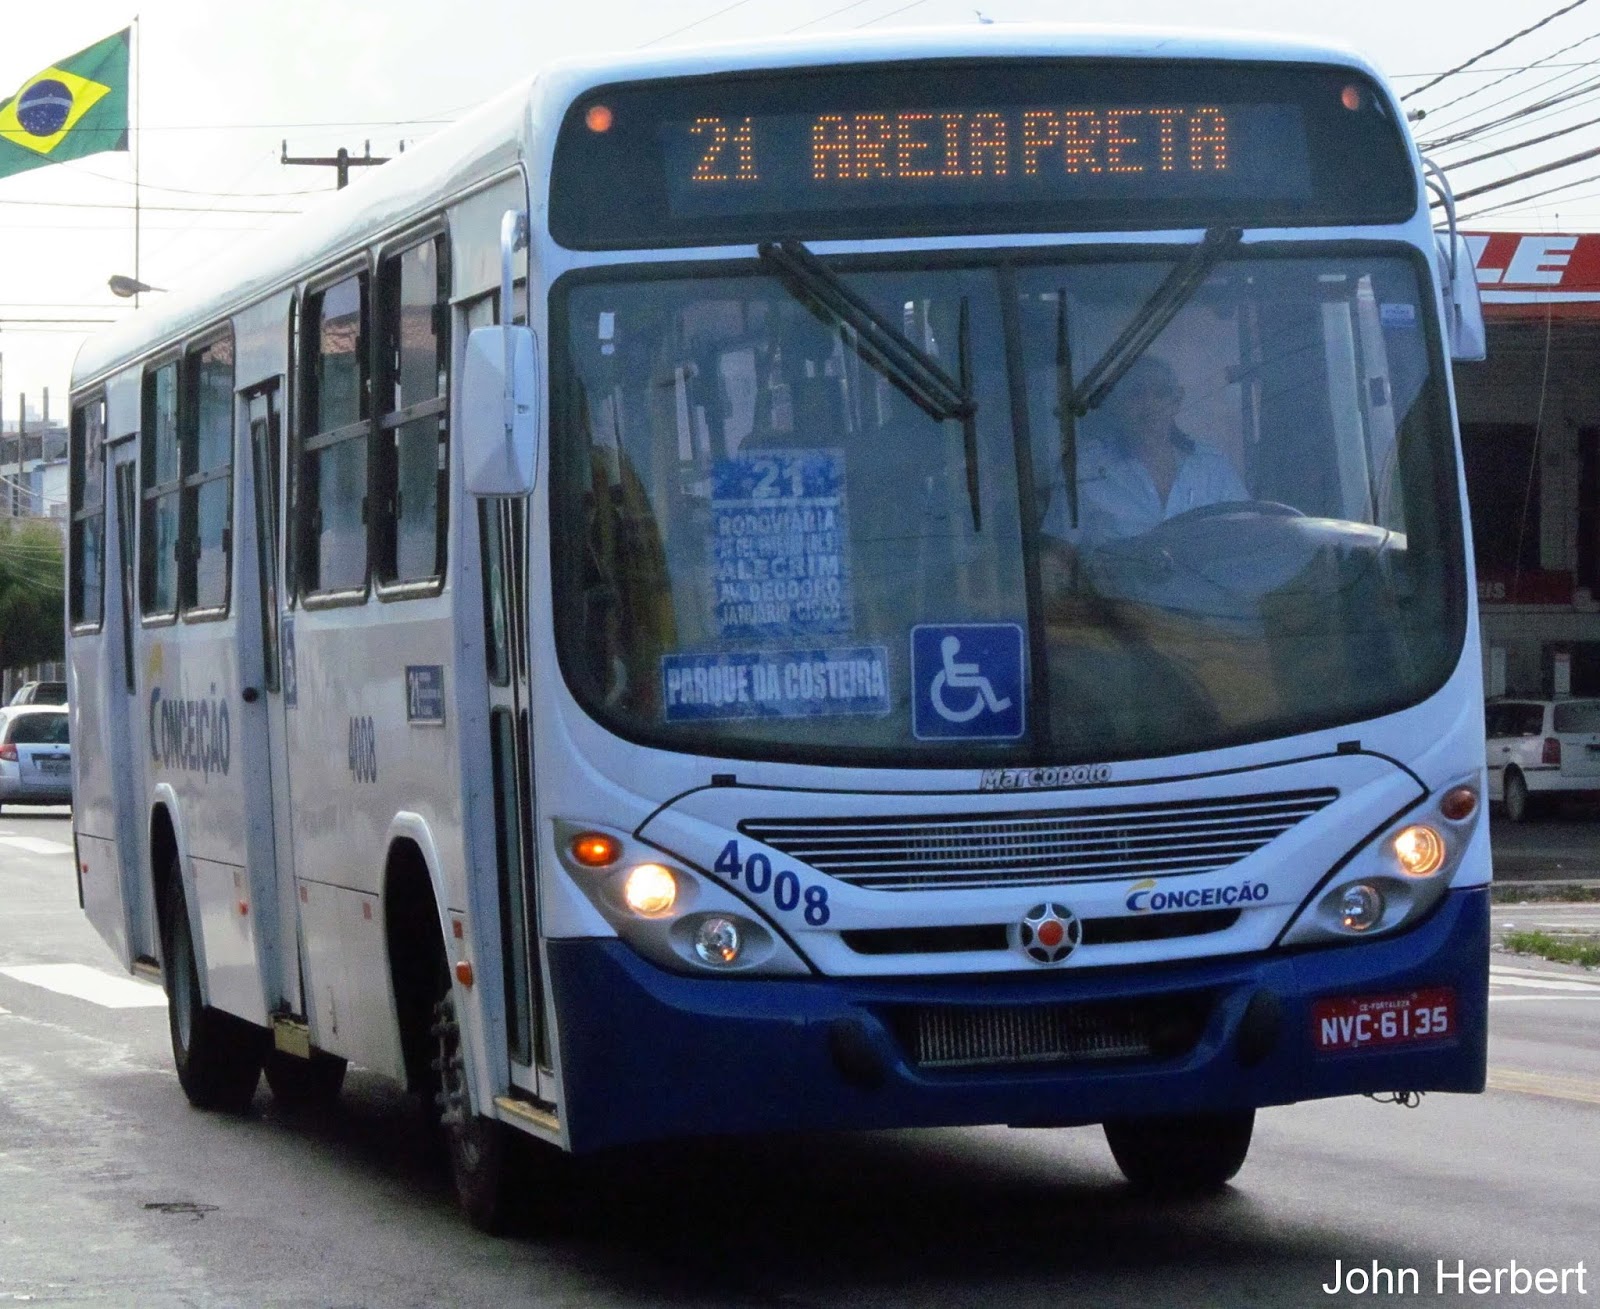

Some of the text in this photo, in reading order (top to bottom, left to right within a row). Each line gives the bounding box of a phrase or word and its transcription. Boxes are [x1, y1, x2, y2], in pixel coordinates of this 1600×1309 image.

[691, 108, 1225, 180] 21 AREIA PRETA
[752, 460, 804, 498] 21
[719, 554, 840, 580] ALECRIM
[749, 576, 841, 602] DEODORO
[667, 659, 886, 706] PARQUE DA COSTEIRA
[149, 682, 231, 784] CONCEIÇÃO
[348, 716, 377, 784] 4008
[979, 763, 1112, 790] Marcopolo
[713, 838, 831, 926] 4008
[1125, 880, 1269, 912] CONCEIÇÃO
